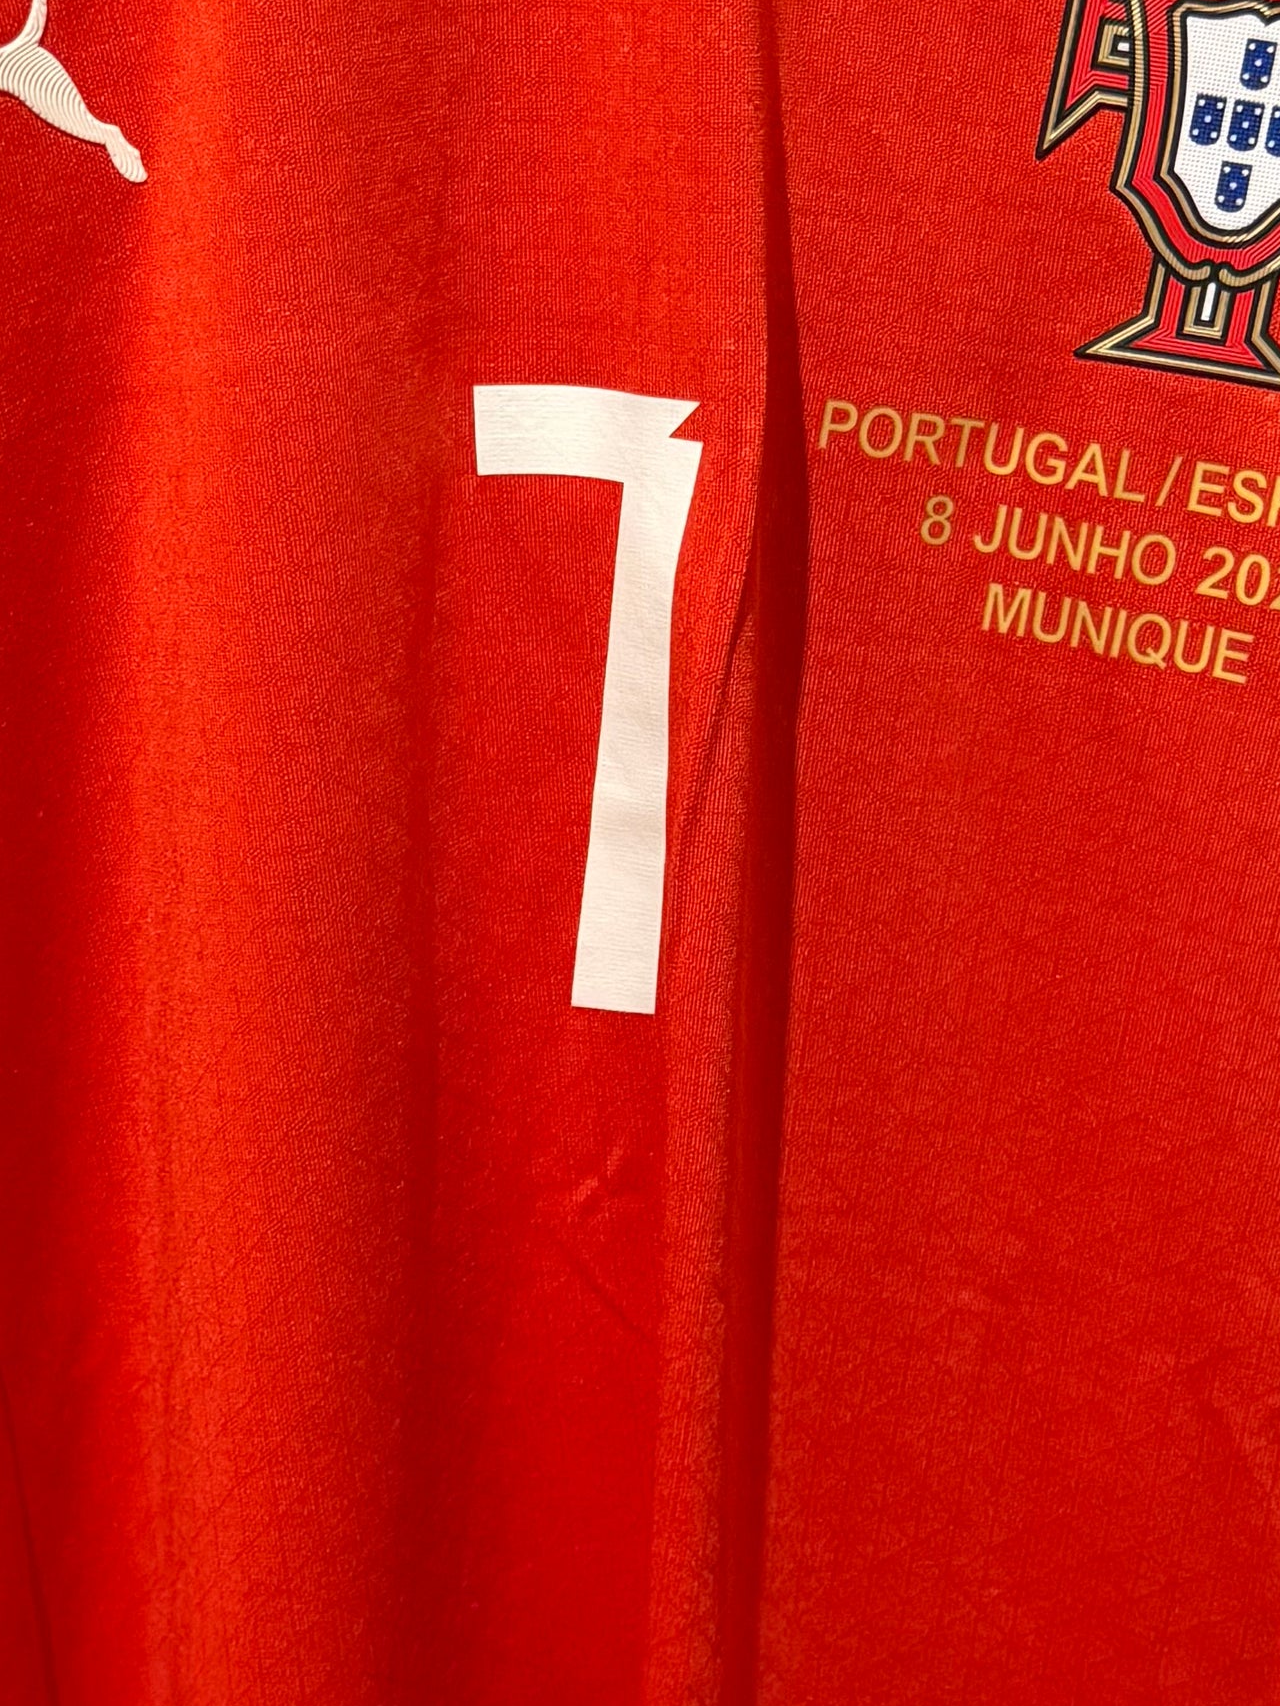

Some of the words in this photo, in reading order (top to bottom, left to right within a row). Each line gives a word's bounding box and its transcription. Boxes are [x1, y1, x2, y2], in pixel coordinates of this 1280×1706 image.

[921, 495, 953, 545] 8
[973, 504, 1177, 586] JUNHO
[981, 582, 1256, 684] MUNIQUE
[472, 383, 703, 1015] 7
